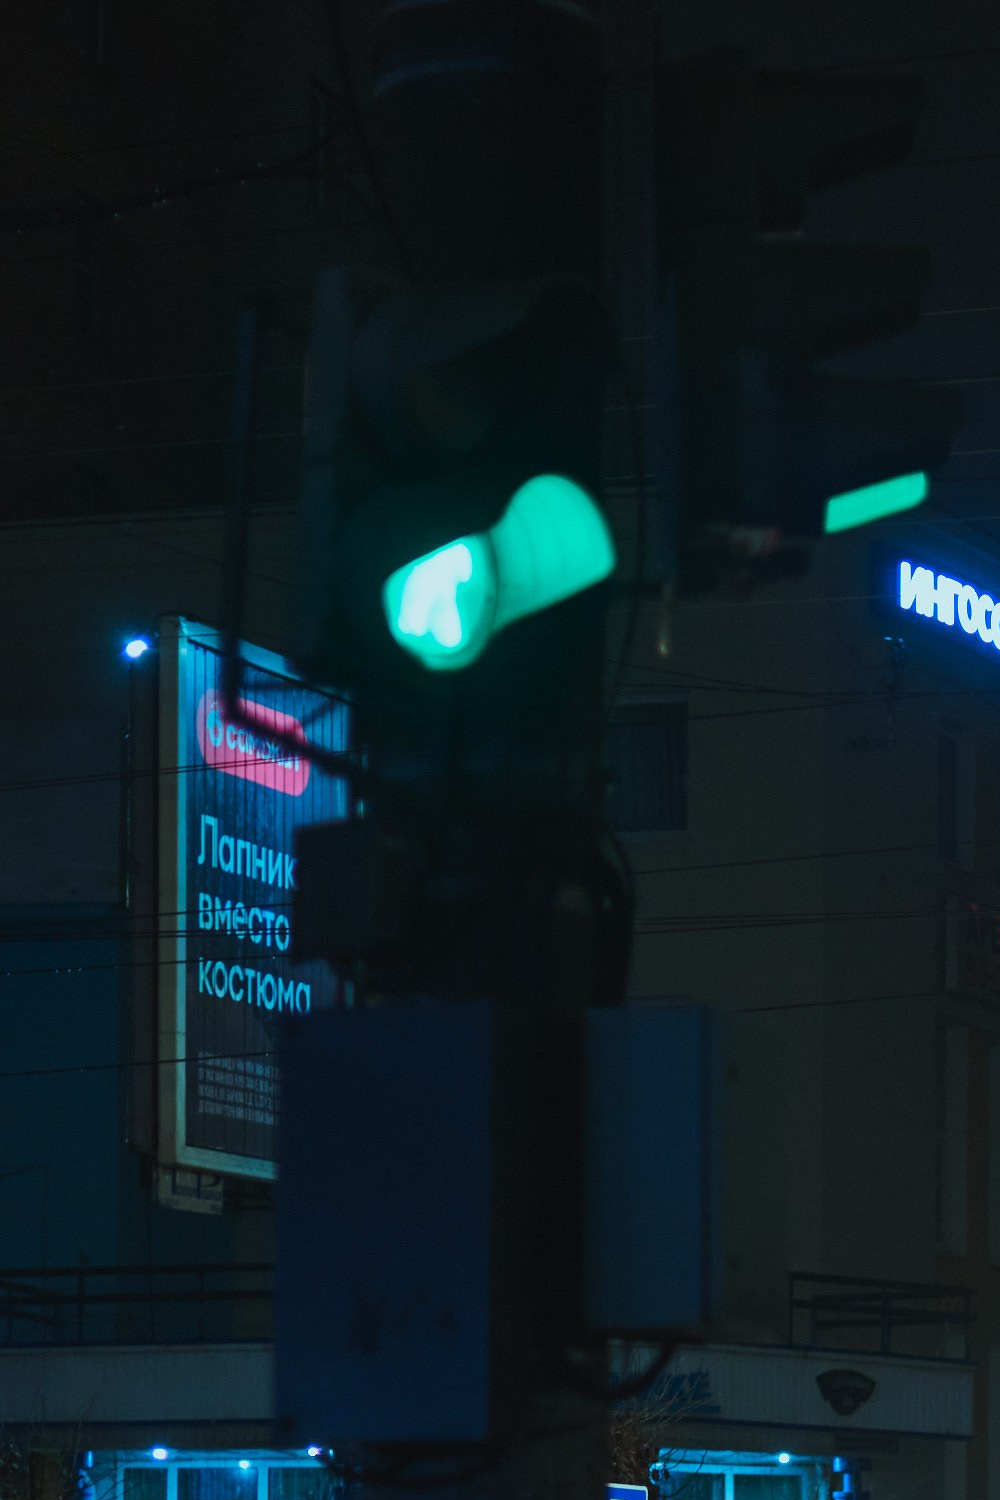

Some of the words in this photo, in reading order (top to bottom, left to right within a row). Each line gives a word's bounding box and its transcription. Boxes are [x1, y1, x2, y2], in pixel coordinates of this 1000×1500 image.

[198, 813, 298, 890] Лапник
[199, 892, 290, 951] вместо
[199, 956, 311, 1016] костюма
